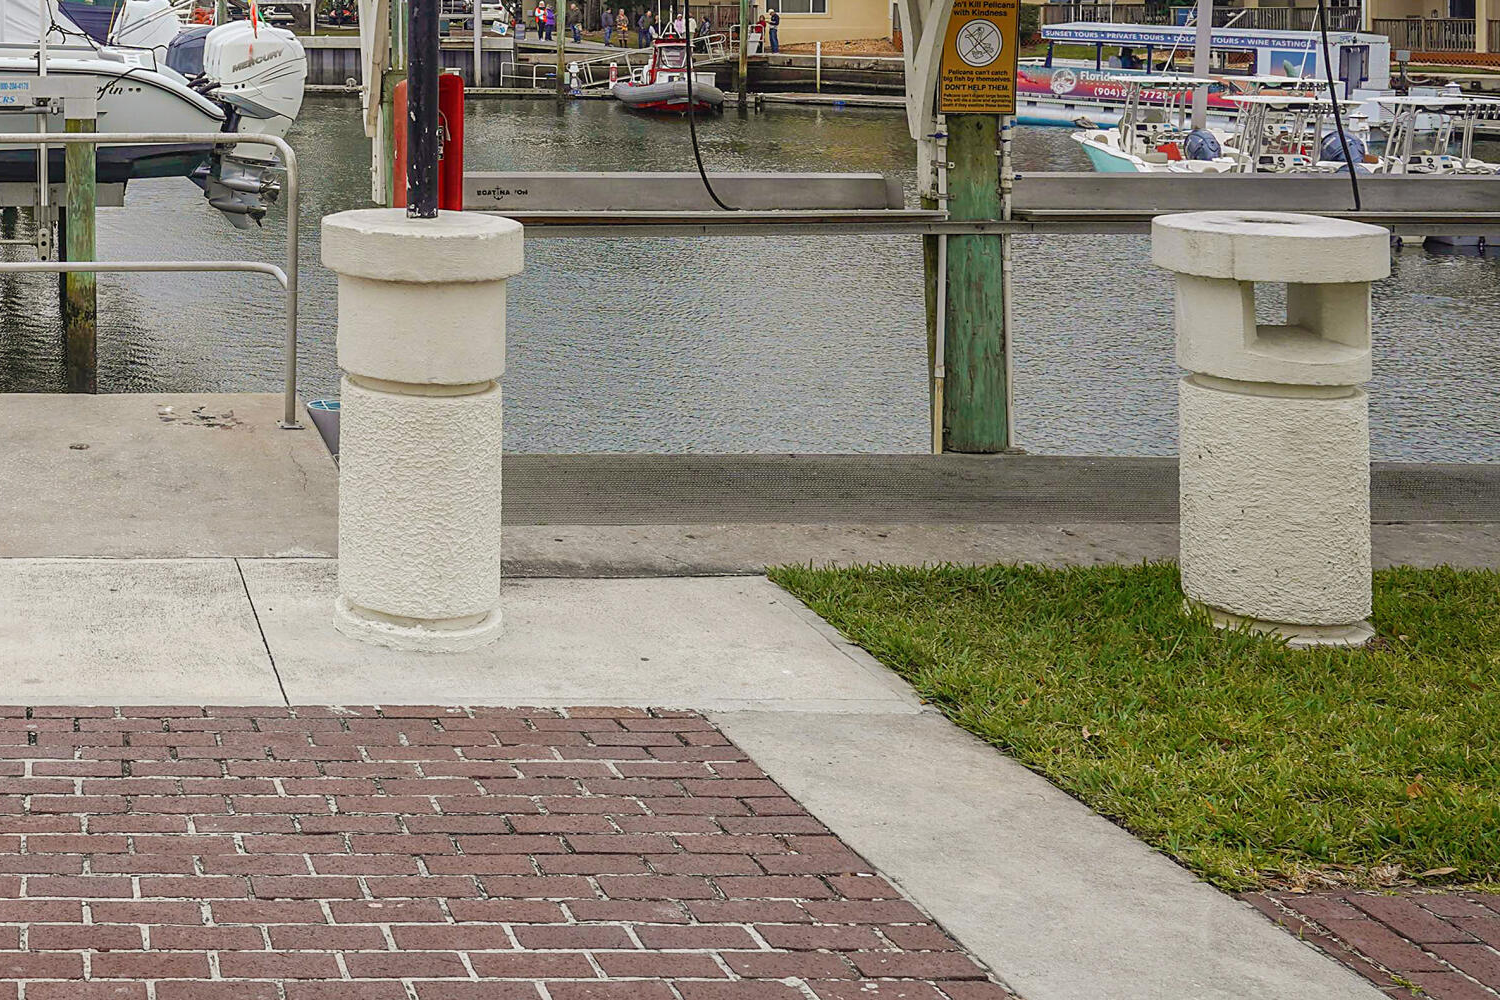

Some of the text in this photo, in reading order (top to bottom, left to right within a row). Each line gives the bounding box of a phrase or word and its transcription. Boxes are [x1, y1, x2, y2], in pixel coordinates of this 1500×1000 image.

[983, 1, 1015, 9] Pelicans
[972, 9, 1008, 17] Kindness
[1247, 38, 1269, 46] WINE
[1272, 40, 1312, 48] TASTINGS
[232, 48, 284, 73] MERCURY
